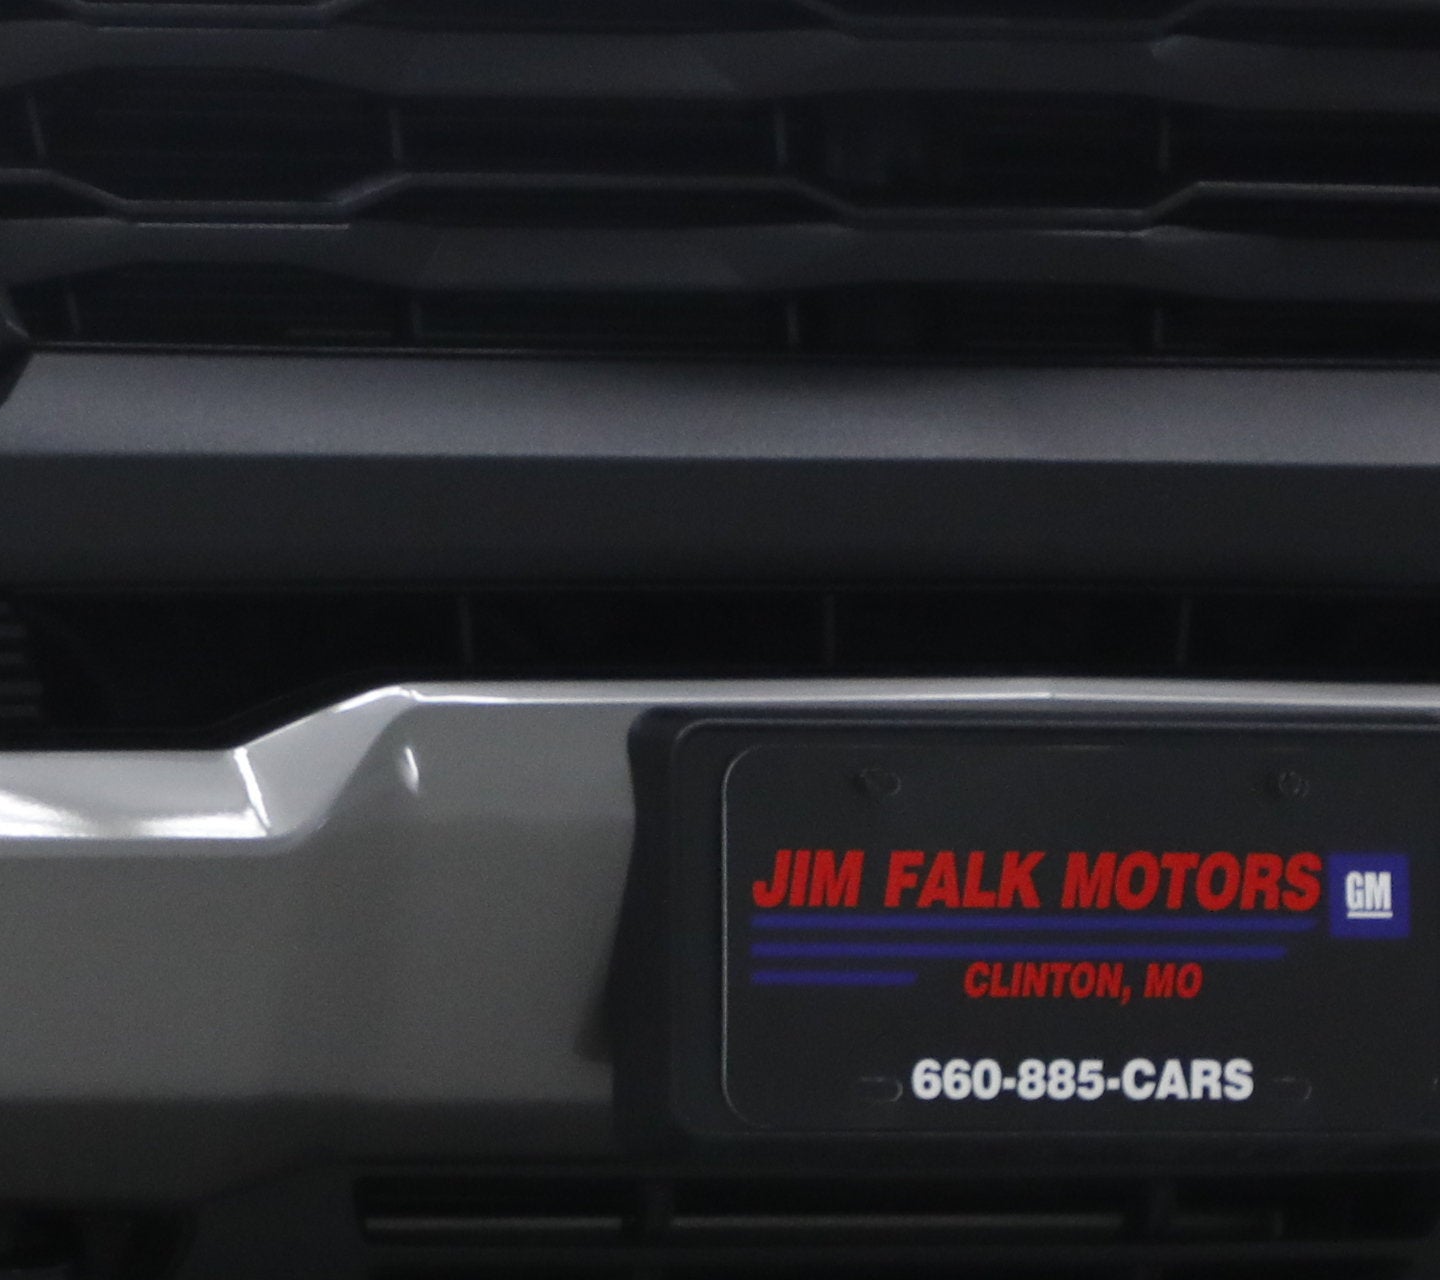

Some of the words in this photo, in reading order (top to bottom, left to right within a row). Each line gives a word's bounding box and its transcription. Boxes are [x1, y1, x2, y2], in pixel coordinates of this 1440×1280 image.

[752, 848, 865, 908] JIM
[883, 849, 1046, 909] FALK
[1060, 850, 1322, 912] MOTORS
[1345, 870, 1392, 909] GM
[963, 960, 1132, 1005] CLINTON,
[1143, 962, 1204, 999] MO
[911, 1057, 1254, 1101] 660-885-CARS
